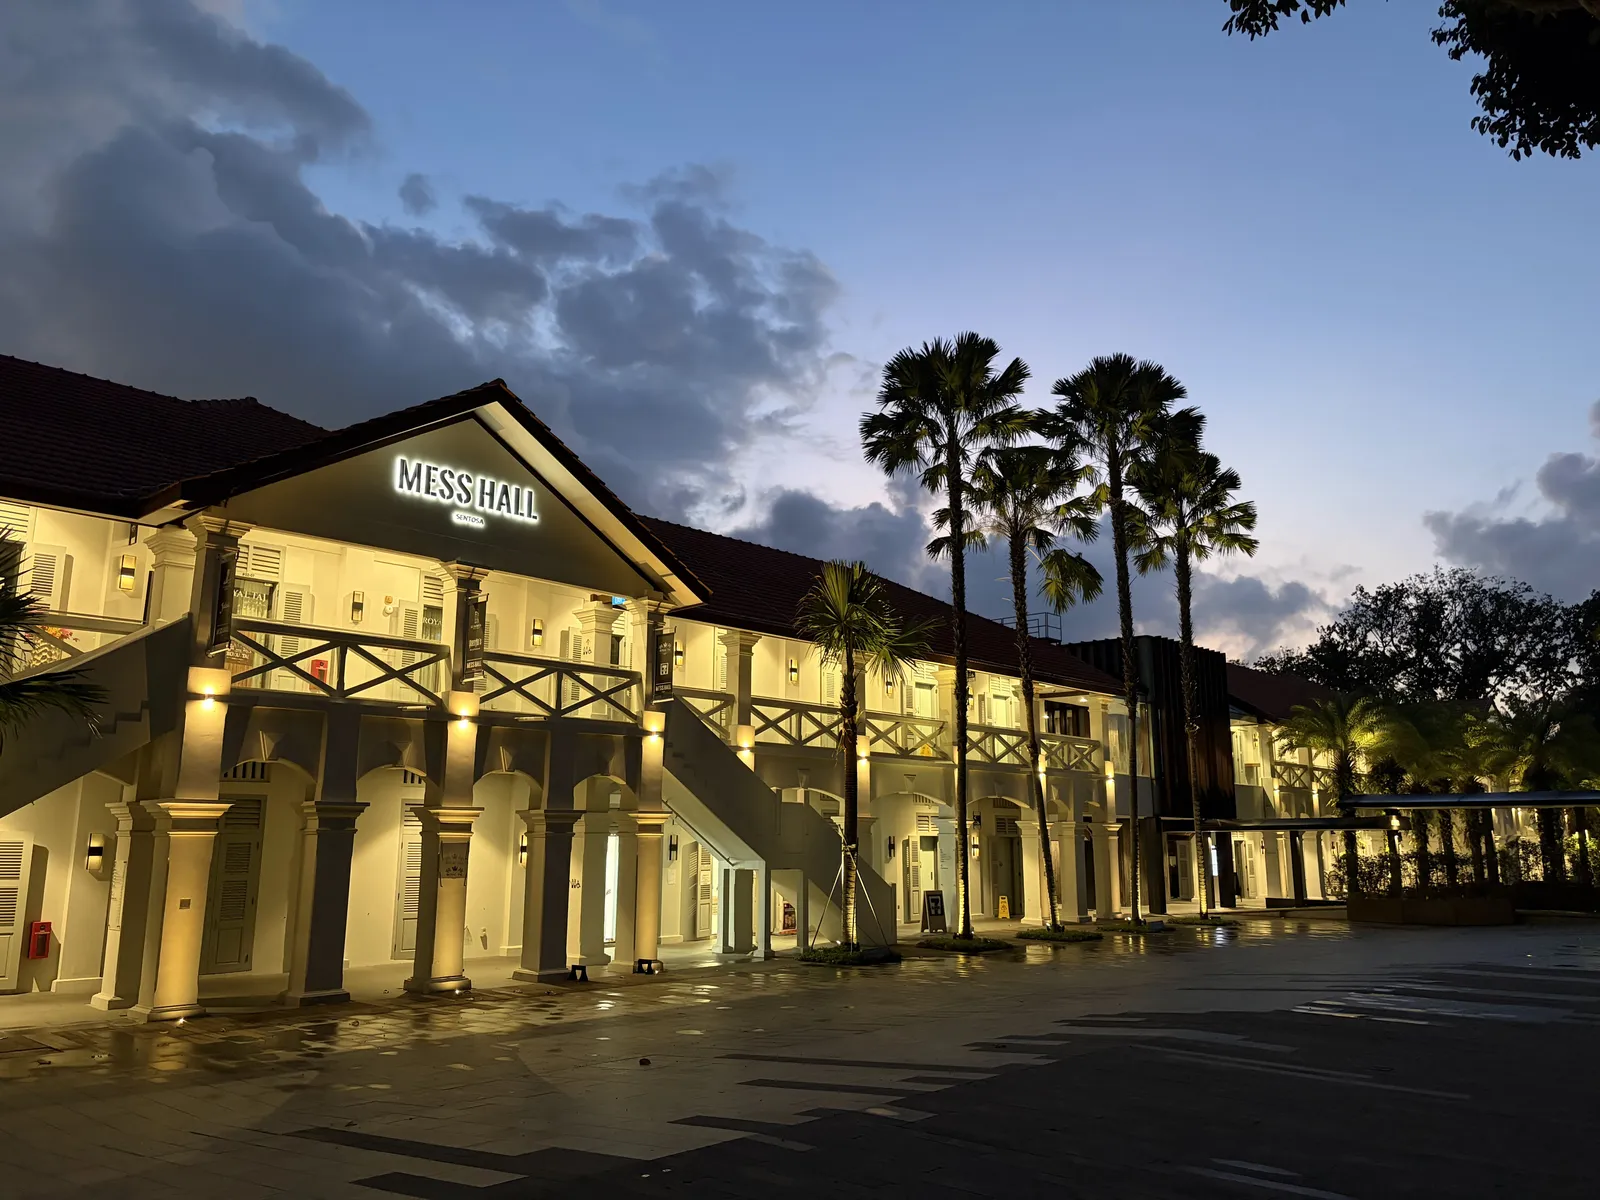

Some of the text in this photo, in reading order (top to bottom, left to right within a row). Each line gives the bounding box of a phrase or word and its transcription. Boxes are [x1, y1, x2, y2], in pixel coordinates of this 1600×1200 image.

[398, 458, 538, 519] MESS HALL
[455, 513, 485, 525] SENTOSA
